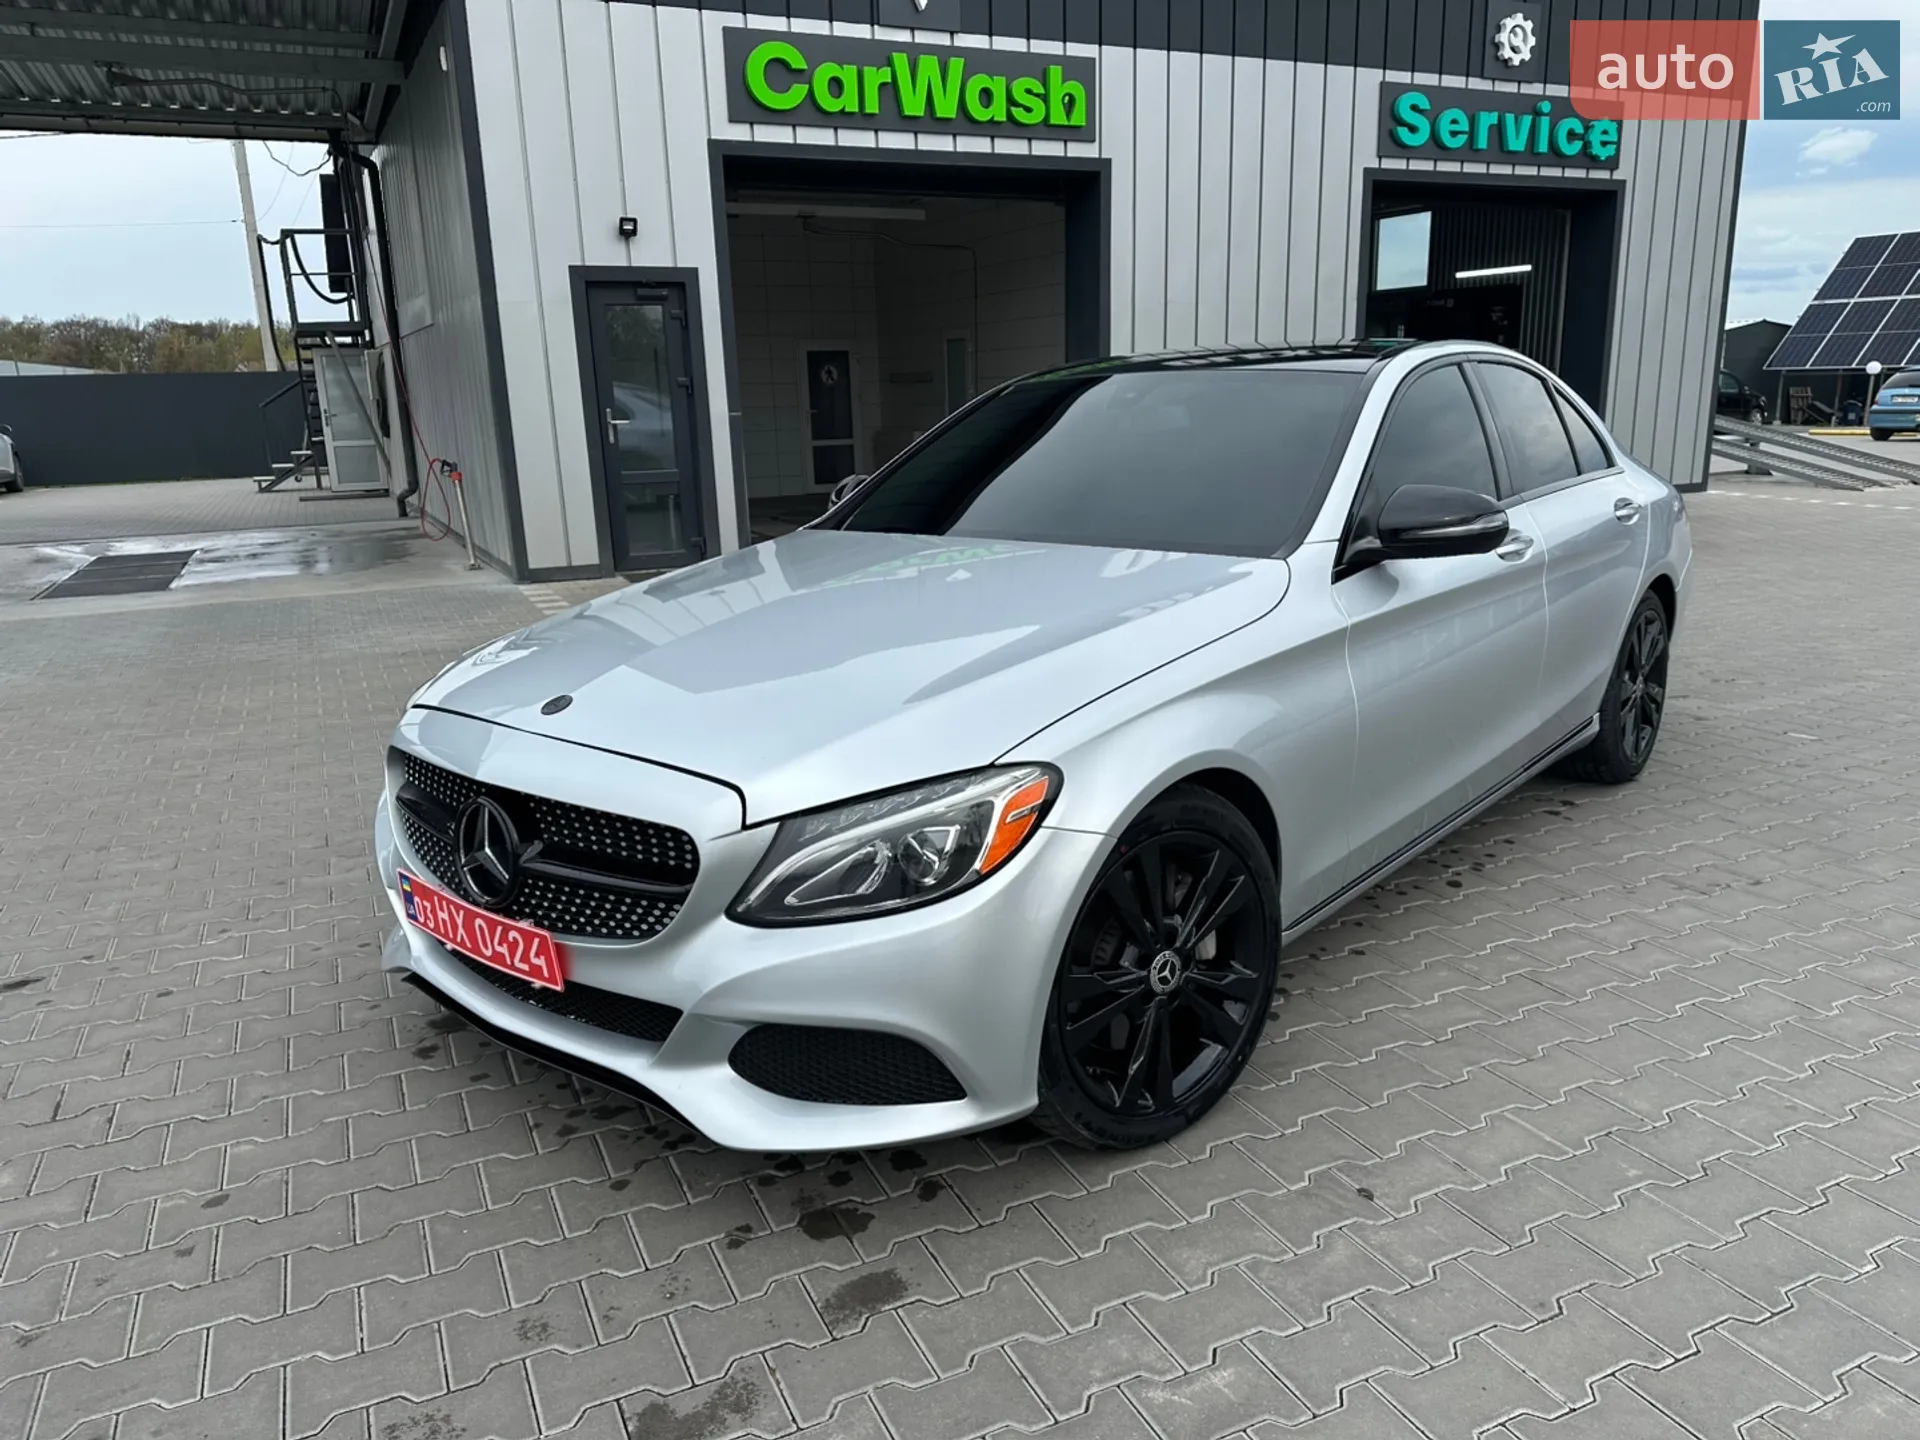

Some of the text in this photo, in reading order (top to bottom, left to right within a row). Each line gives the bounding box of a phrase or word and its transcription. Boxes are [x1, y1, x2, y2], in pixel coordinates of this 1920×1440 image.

[744, 41, 1087, 127] CarWash
[1391, 91, 1619, 161] Service
[474, 917, 550, 979] 0424
